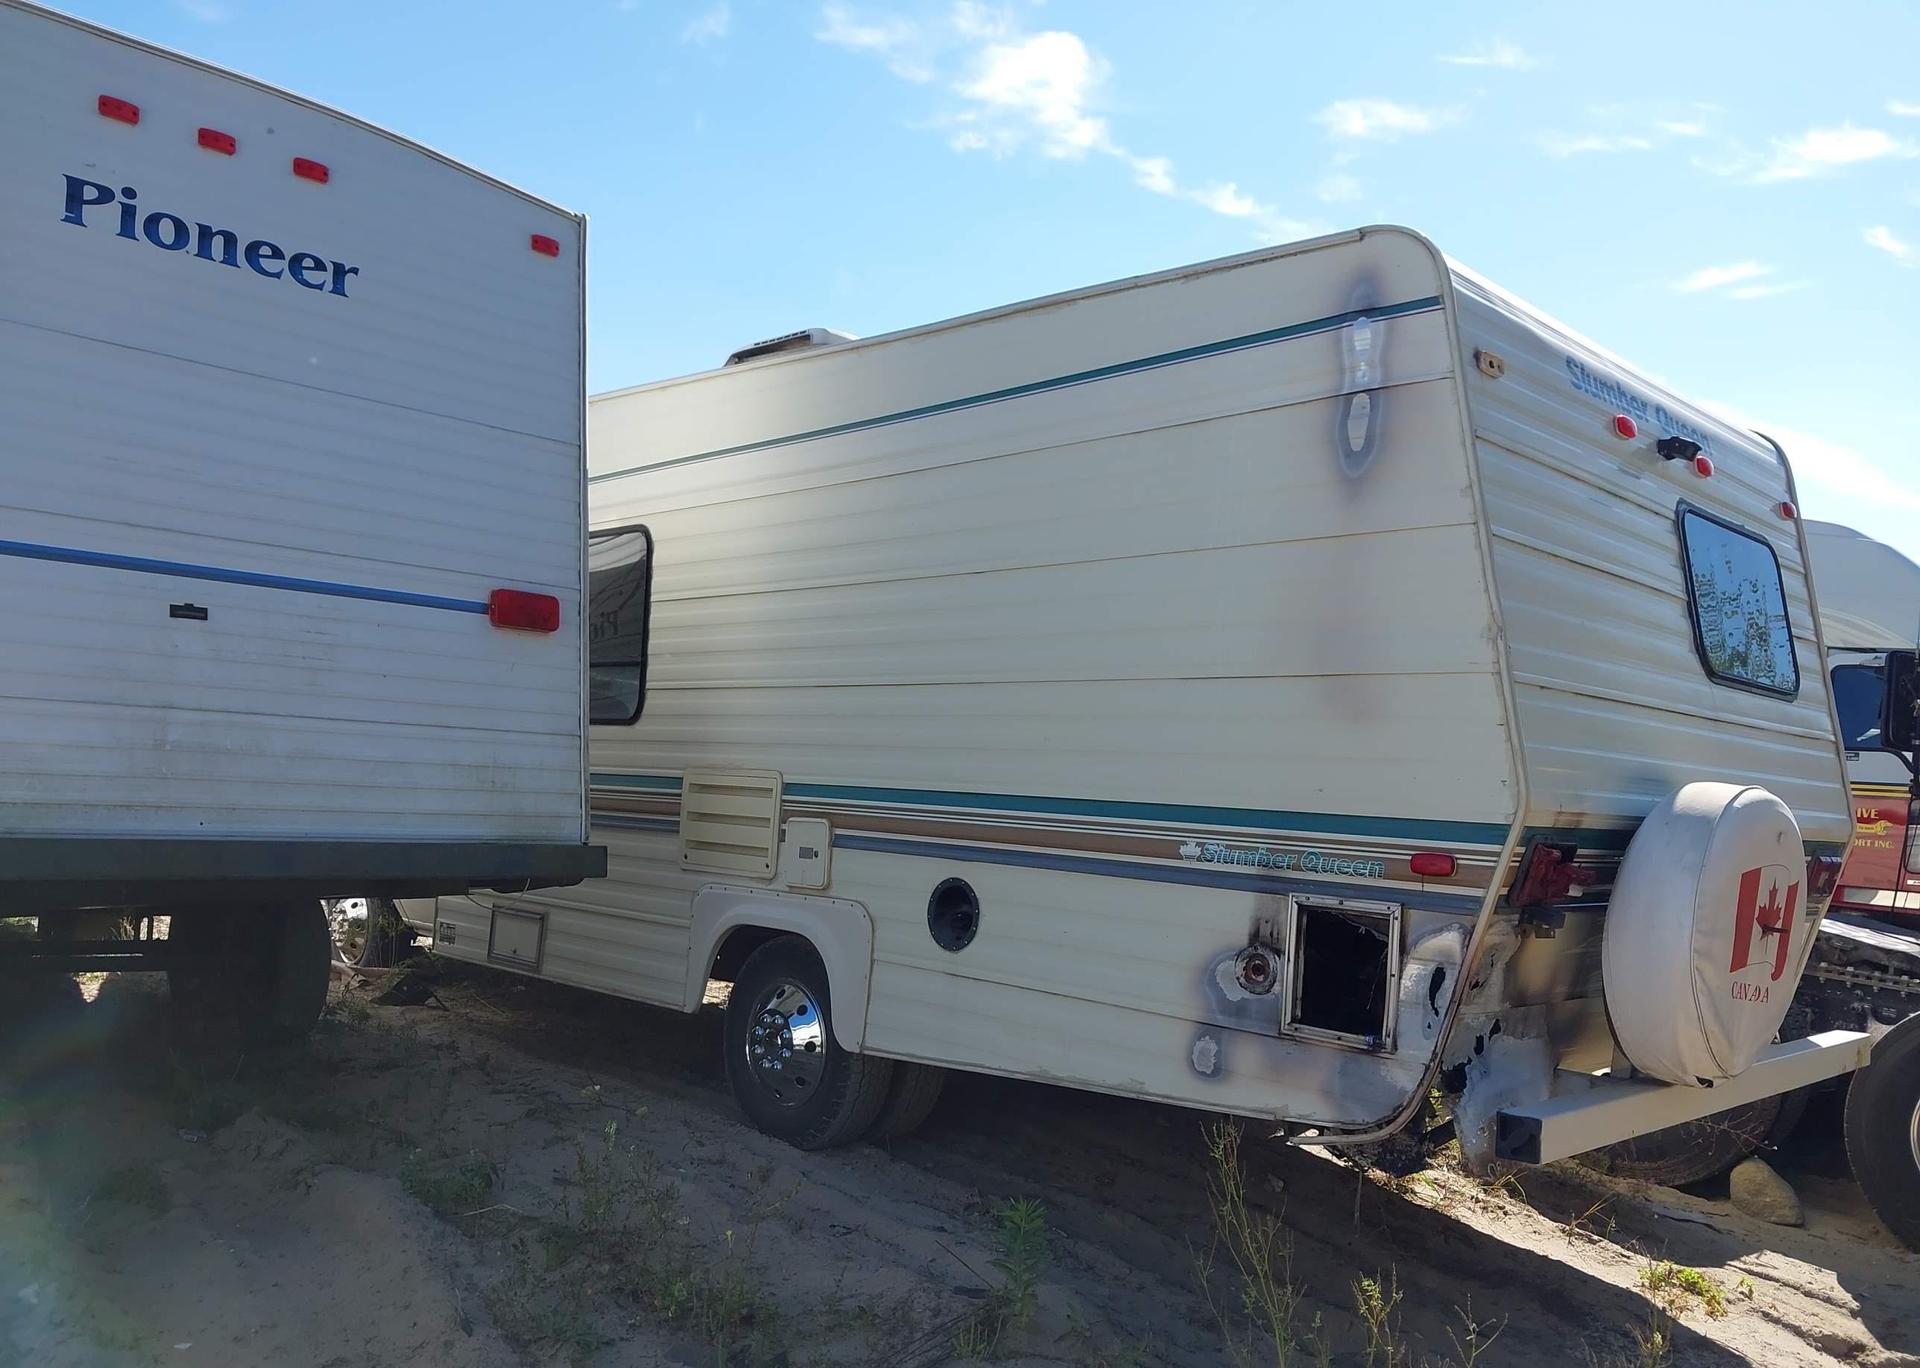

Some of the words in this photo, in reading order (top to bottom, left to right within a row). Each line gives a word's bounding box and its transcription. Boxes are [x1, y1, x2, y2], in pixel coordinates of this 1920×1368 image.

[61, 173, 360, 299] Pioneer
[1565, 355, 1649, 423] Slumber
[1201, 842, 1297, 870] Slumber
[1301, 848, 1385, 879] Queen
[1731, 981, 1769, 1003] CANADA
